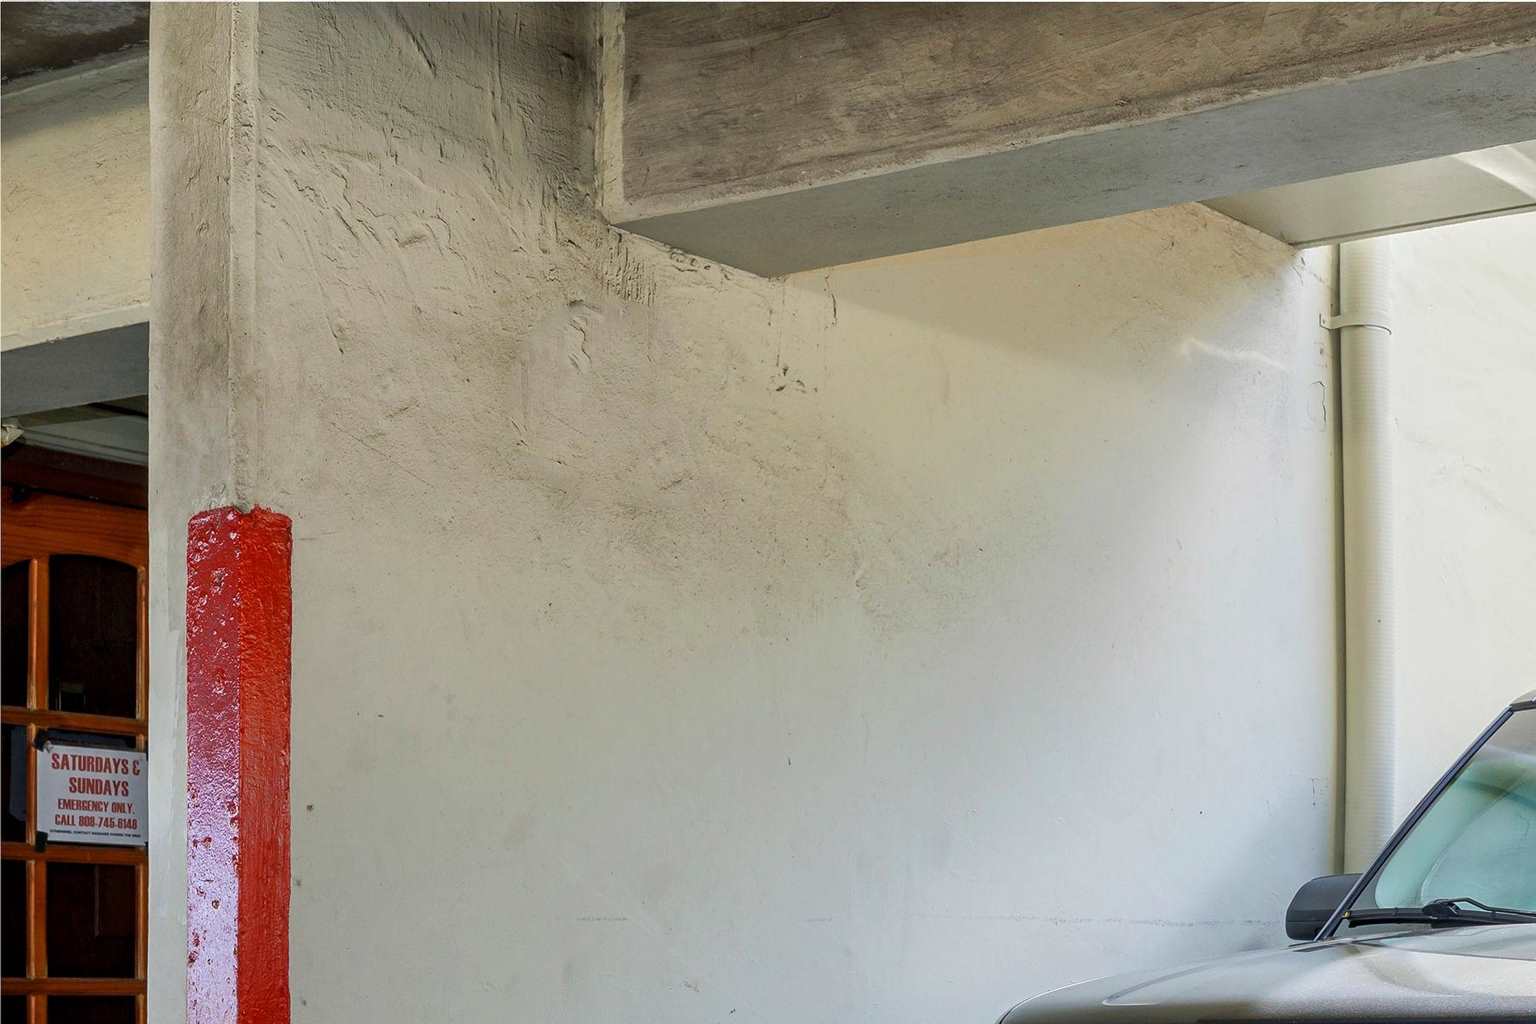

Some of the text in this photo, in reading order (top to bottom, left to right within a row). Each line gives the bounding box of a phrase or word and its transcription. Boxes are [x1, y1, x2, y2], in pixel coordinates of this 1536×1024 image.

[51, 753, 141, 776] SATURDAYS &
[69, 777, 129, 797] SUNDAYS
[58, 799, 135, 814] EMERGENCY ONLY.
[55, 814, 76, 826] CALL
